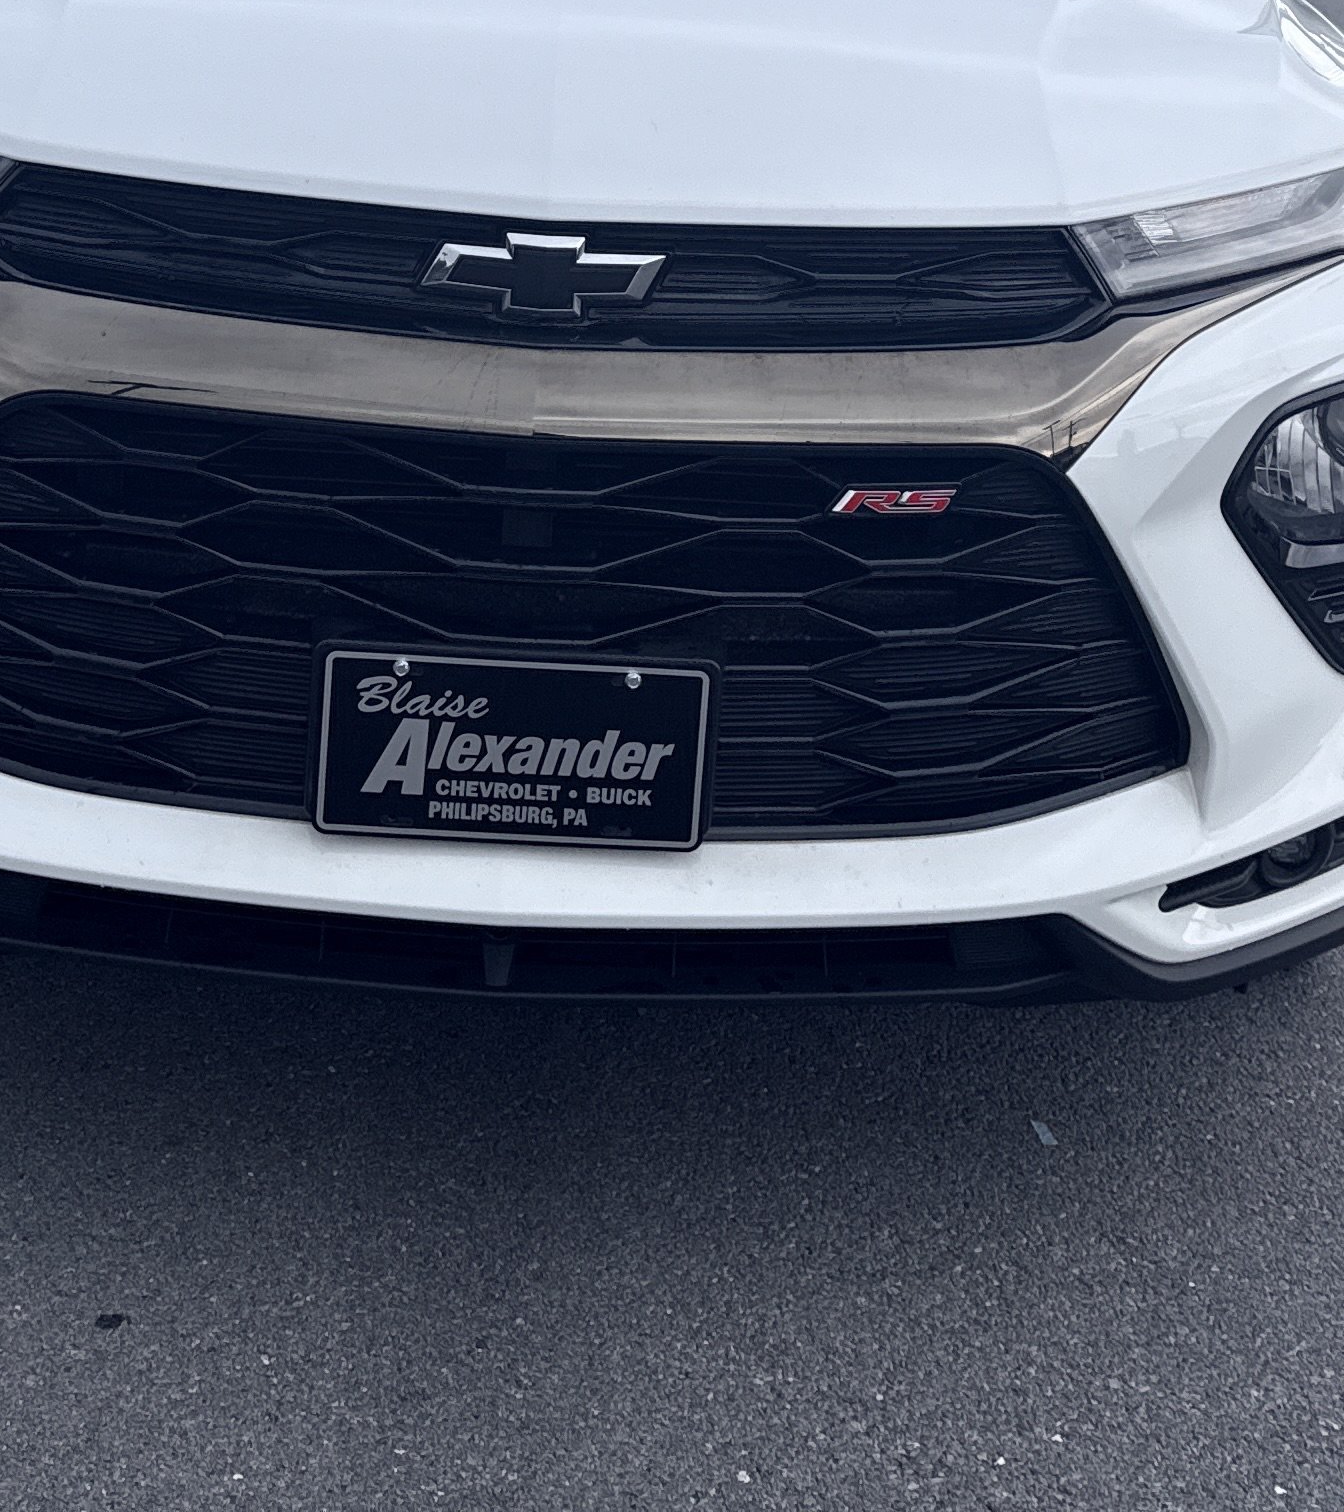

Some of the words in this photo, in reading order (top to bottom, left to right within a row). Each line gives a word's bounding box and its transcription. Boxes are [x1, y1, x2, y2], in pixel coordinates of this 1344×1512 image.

[831, 489, 958, 514] RS
[356, 675, 490, 719] Blaise
[360, 717, 676, 796] Alexander
[435, 778, 562, 802] CHEVROLET
[586, 787, 652, 807] BUICK
[428, 800, 558, 829] PHILIPSBURG,
[562, 808, 588, 827] PA
